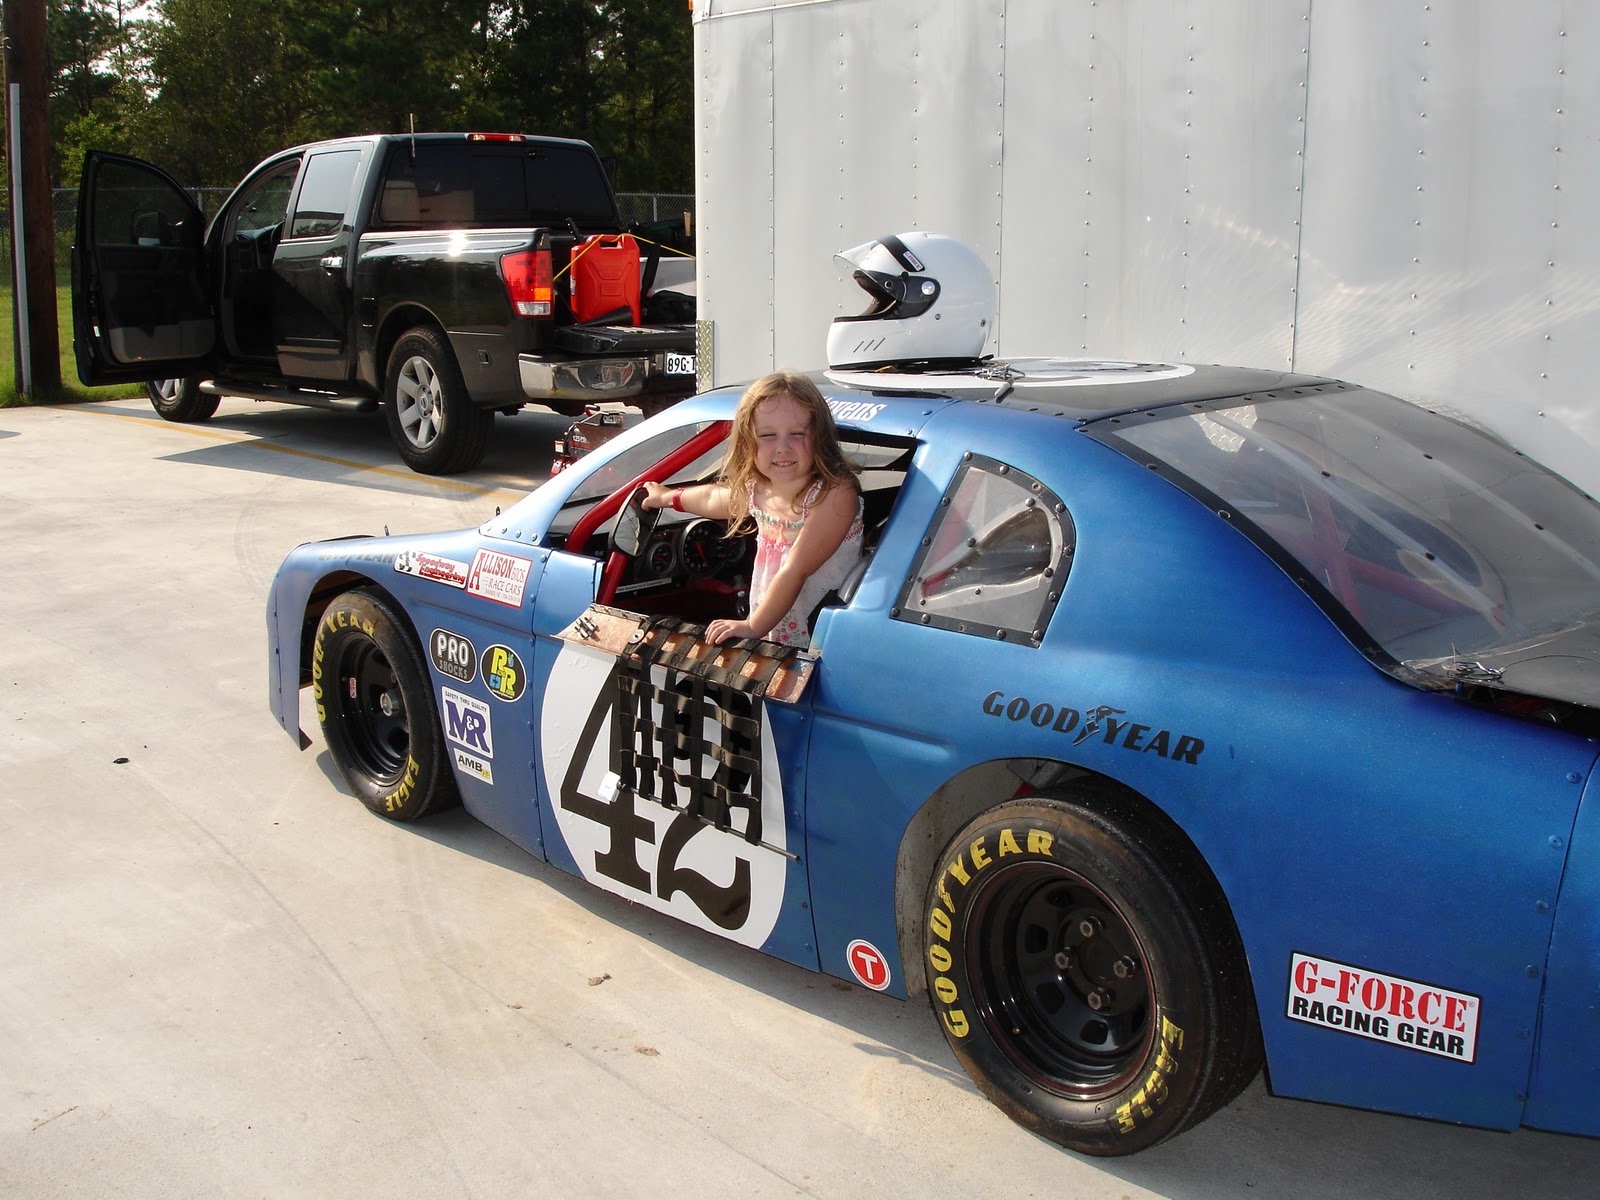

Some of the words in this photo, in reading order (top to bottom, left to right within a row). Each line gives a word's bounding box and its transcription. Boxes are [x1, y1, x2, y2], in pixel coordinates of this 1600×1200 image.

[416, 553, 455, 573] Speedway
[469, 552, 515, 590] ALLISON
[488, 578, 505, 591] RACE
[505, 582, 522, 596] CARS
[437, 632, 469, 668] PRO
[439, 659, 468, 680] SHOCKS
[445, 691, 459, 701] SAFETY
[460, 696, 470, 706] THRU
[471, 702, 487, 713] QUALITY
[982, 690, 1206, 765] GOODYEAR
[458, 754, 483, 772] AMB
[385, 754, 420, 812] EAGLE
[856, 951, 878, 980] T
[1294, 960, 1468, 1033] G-FORCE
[1293, 996, 1390, 1038] RACING
[1397, 1023, 1465, 1057] GEAR
[1116, 1015, 1184, 1134] EAGLE
